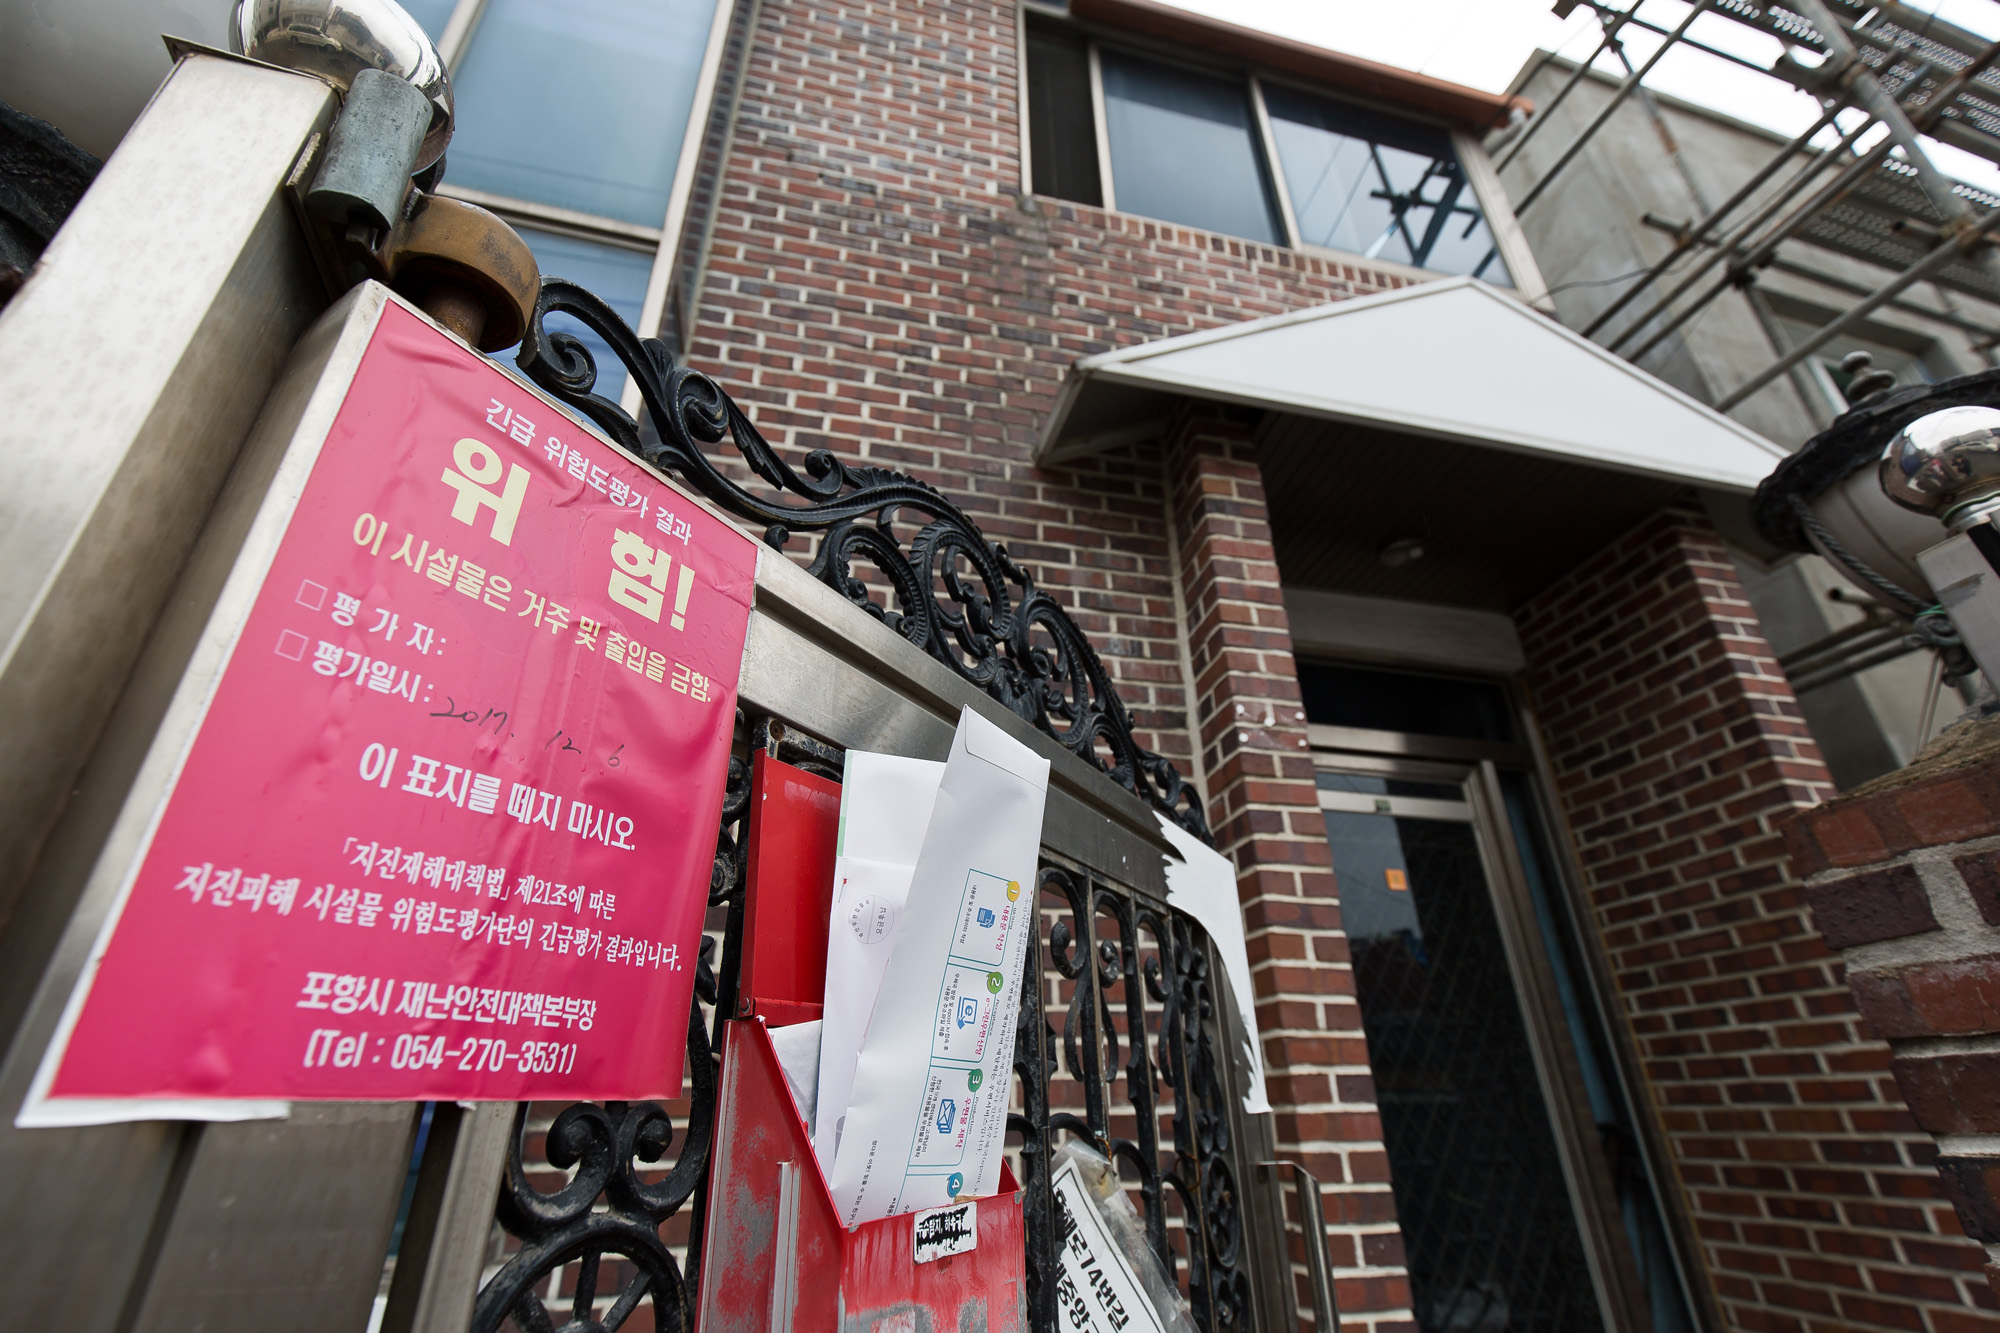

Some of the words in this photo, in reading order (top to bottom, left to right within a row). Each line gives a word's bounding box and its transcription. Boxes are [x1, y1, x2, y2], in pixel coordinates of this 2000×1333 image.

[486, 398, 536, 447] 긴급
[543, 436, 648, 519] 위험도평가
[655, 506, 692, 546] 결과
[440, 437, 532, 547] 위
[608, 527, 695, 632] 험!
[331, 592, 361, 627] 평
[368, 607, 399, 641] 가
[405, 622, 446, 655] 자:
[352, 513, 388, 556] 이
[390, 533, 512, 612] 시설물은
[517, 590, 570, 635] 거주
[574, 615, 601, 652] 및
[604, 630, 666, 683] 출입을
[670, 661, 712, 703] 금함.
[312, 640, 434, 703] 평가일시:
[545, 730, 581, 755] 12
[607, 744, 625, 767] 6
[359, 742, 399, 788] 이
[401, 754, 501, 815] 표지를
[506, 782, 562, 831] 떼지
[567, 800, 635, 850] 마시오.
[174, 862, 301, 917] 지진피해
[302, 883, 383, 928] 시설물
[389, 897, 535, 949] 위험도평가단의
[539, 921, 602, 959] 긴급평가
[605, 934, 682, 972] 결과입니다.
[514, 874, 585, 915] 제21조에
[589, 890, 616, 921] 따른
[1000, 905, 1010, 930] 내용문
[995, 932, 1005, 950] 작성
[296, 971, 395, 1016] 포항시
[395, 981, 597, 1031] 재난안전대책본부장
[991, 977, 1000, 986] 2
[979, 997, 992, 1038] e-그린우편
[975, 1039, 984, 1055] 신청
[972, 1074, 981, 1085] 3
[960, 1096, 972, 1126] 우편물
[969, 1096, 979, 1135] Production
[955, 1127, 965, 1149] 제작
[951, 1177, 960, 1190] 4
